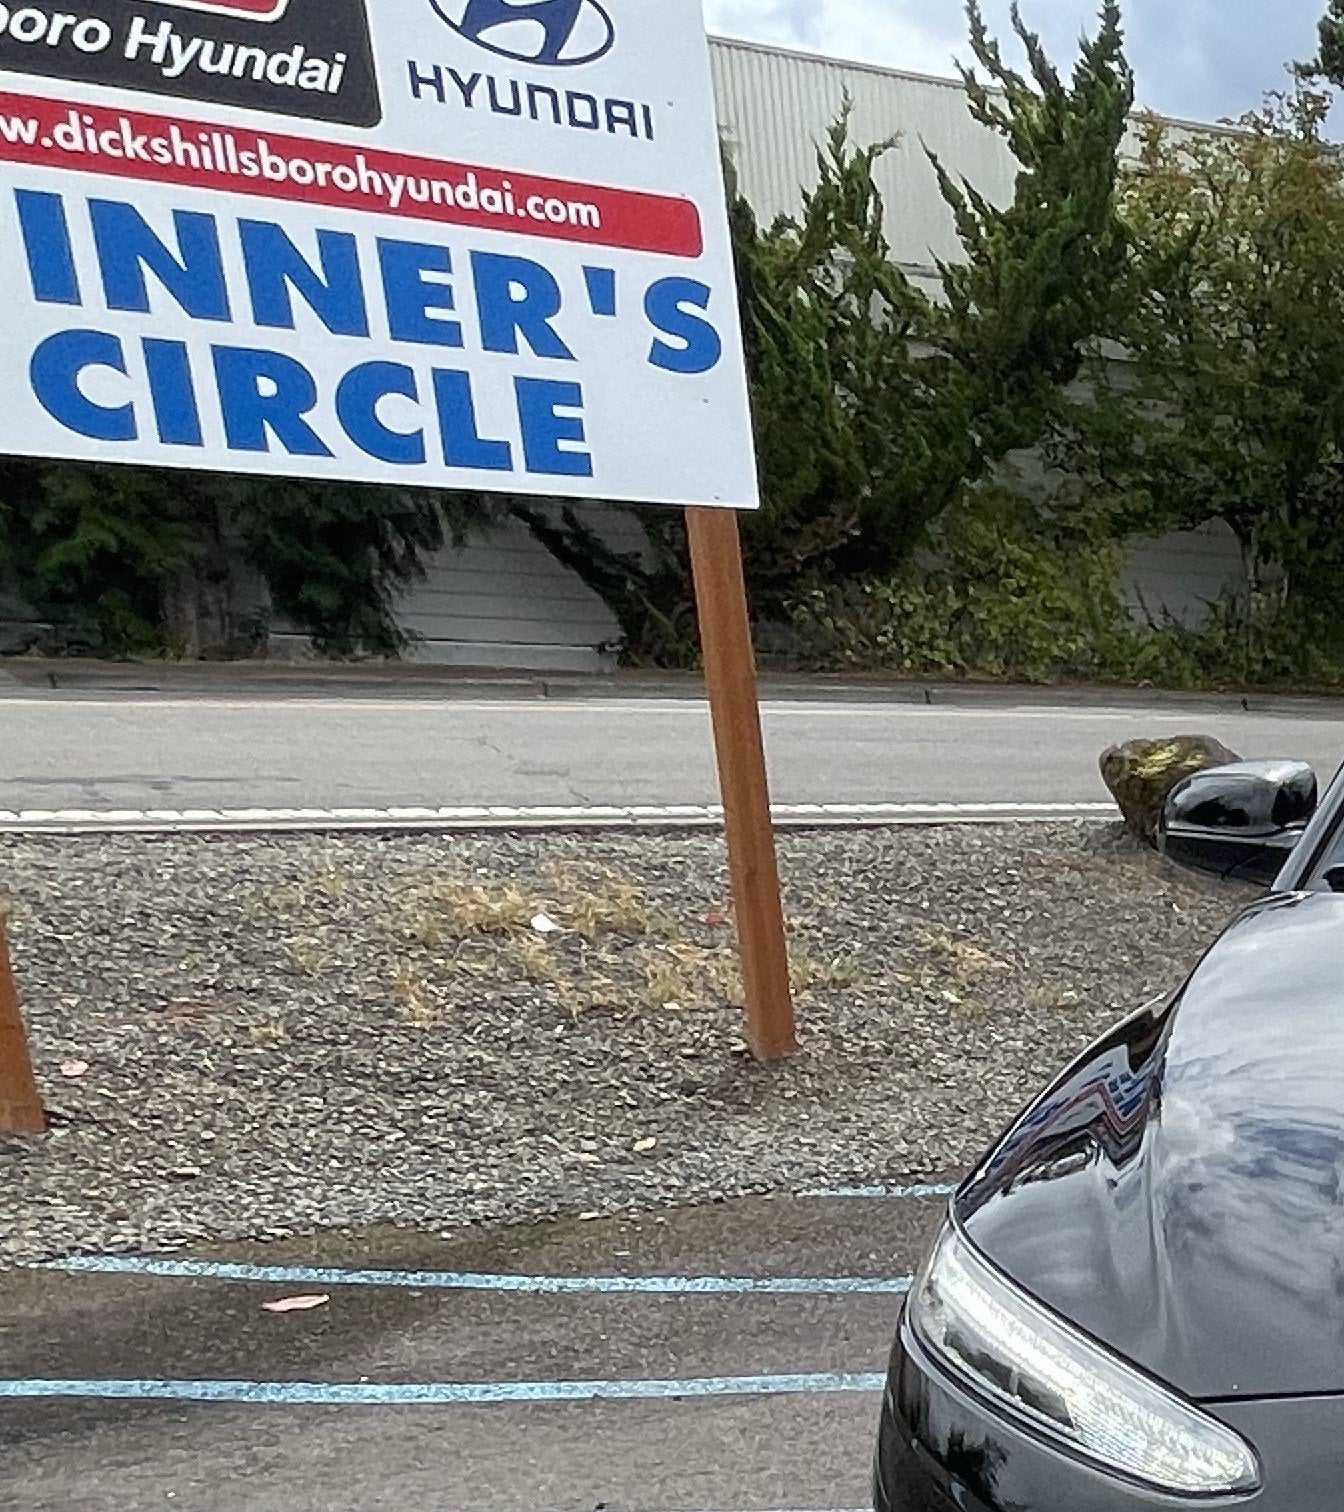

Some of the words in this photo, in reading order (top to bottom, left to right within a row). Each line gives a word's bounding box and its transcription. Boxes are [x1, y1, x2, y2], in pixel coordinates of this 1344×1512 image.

[0, 3, 111, 52] oro
[125, 26, 347, 95] Hyundai
[407, 60, 654, 140] HYUNDAI
[13, 187, 722, 374] INNER'S
[30, 328, 593, 478] CIRCLE
